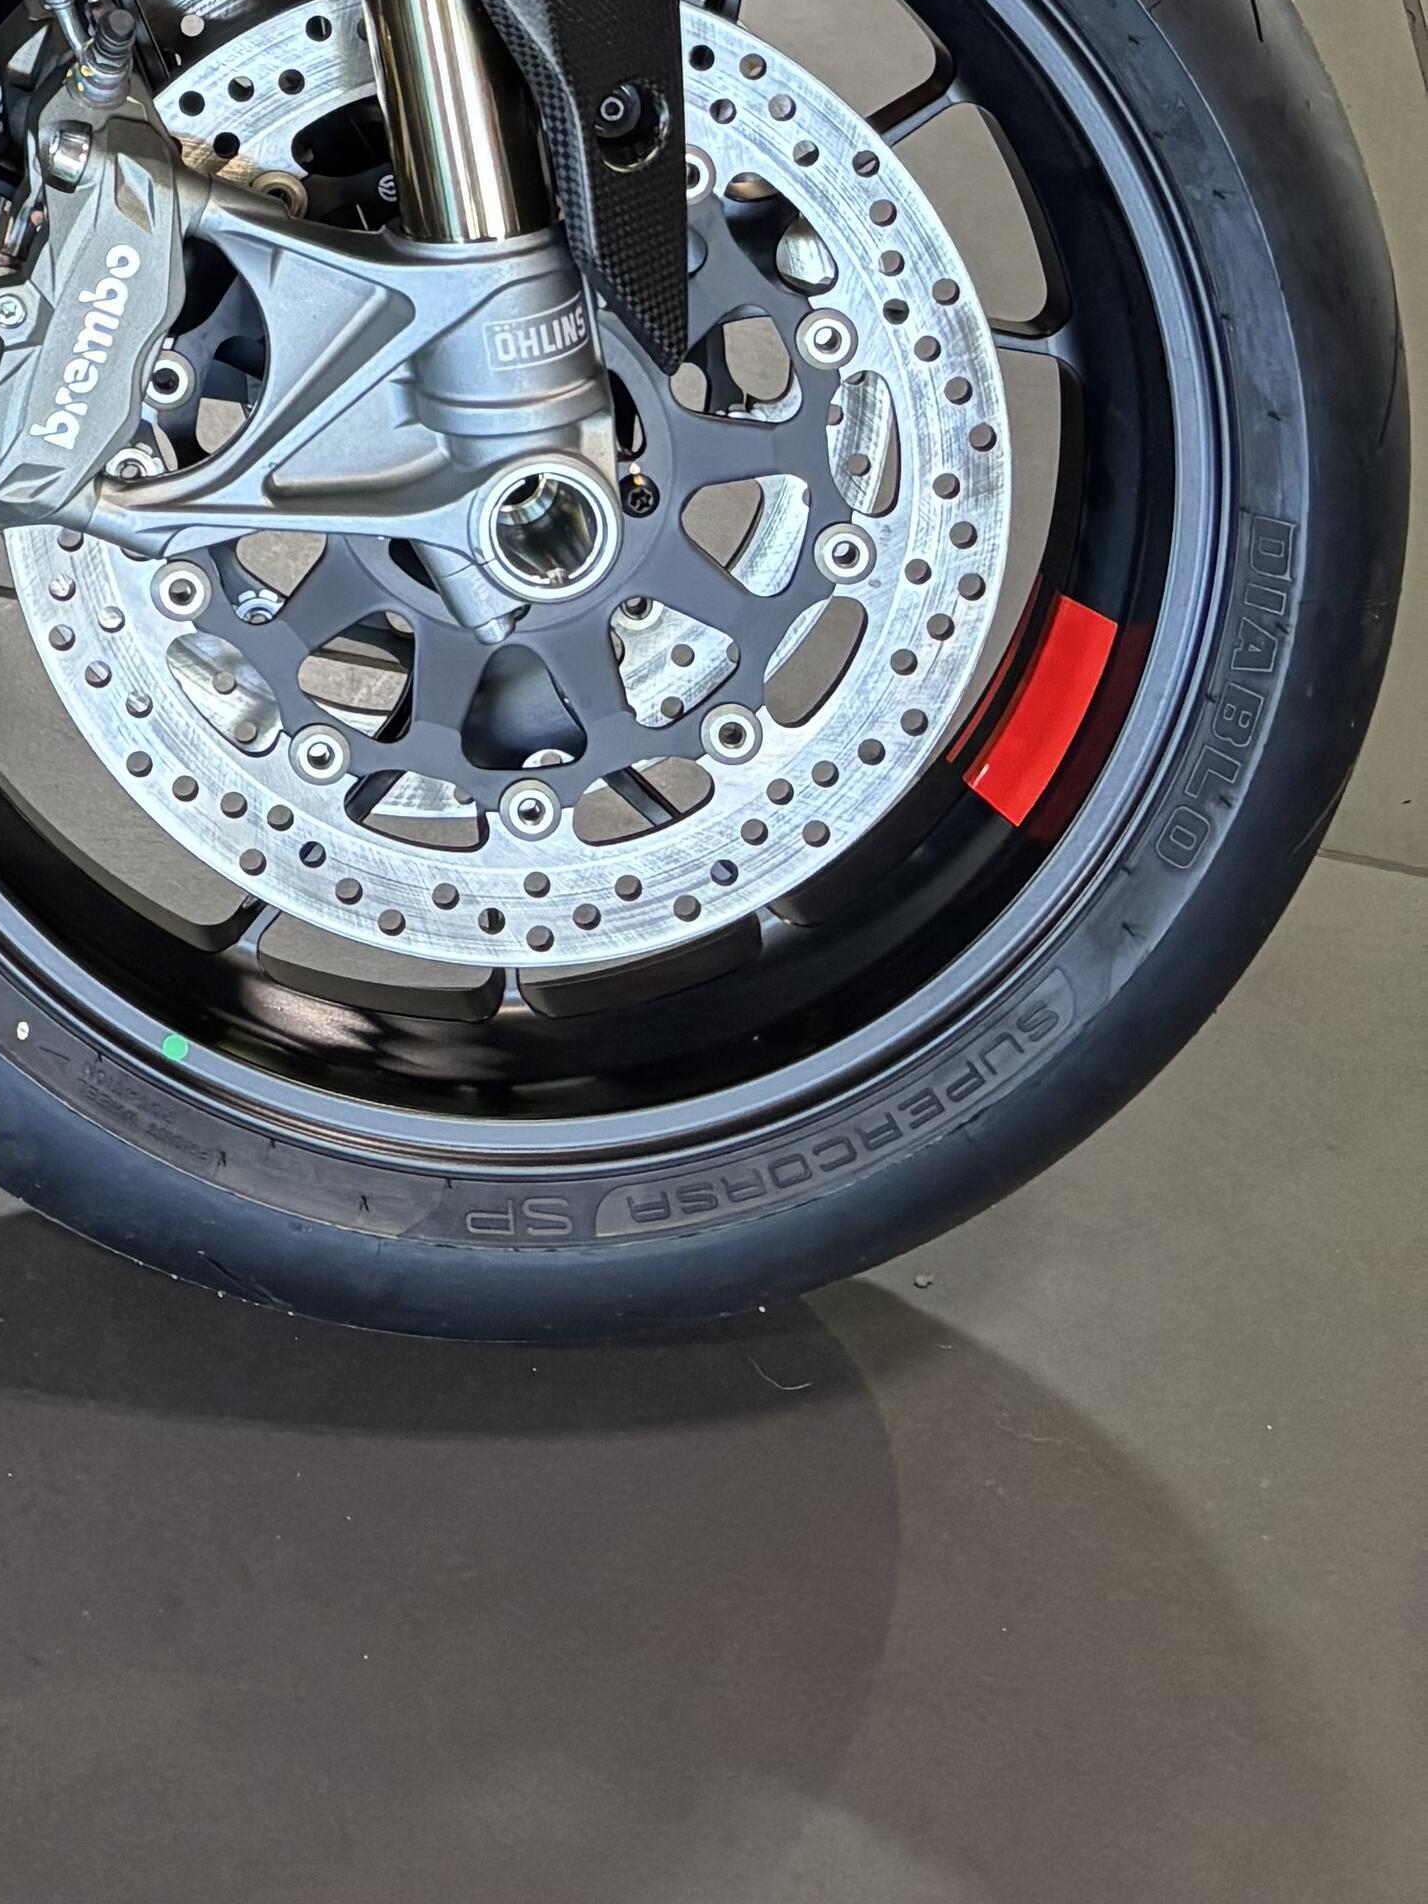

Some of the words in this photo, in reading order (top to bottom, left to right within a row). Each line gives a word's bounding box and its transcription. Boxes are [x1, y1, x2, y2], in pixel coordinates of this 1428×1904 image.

[29, 243, 142, 451] brembo
[492, 305, 591, 365] ÖHLINS
[1154, 510, 1296, 873] DIABLO
[625, 982, 1065, 1227] SUPERCORSA
[465, 1193, 575, 1238] SP
